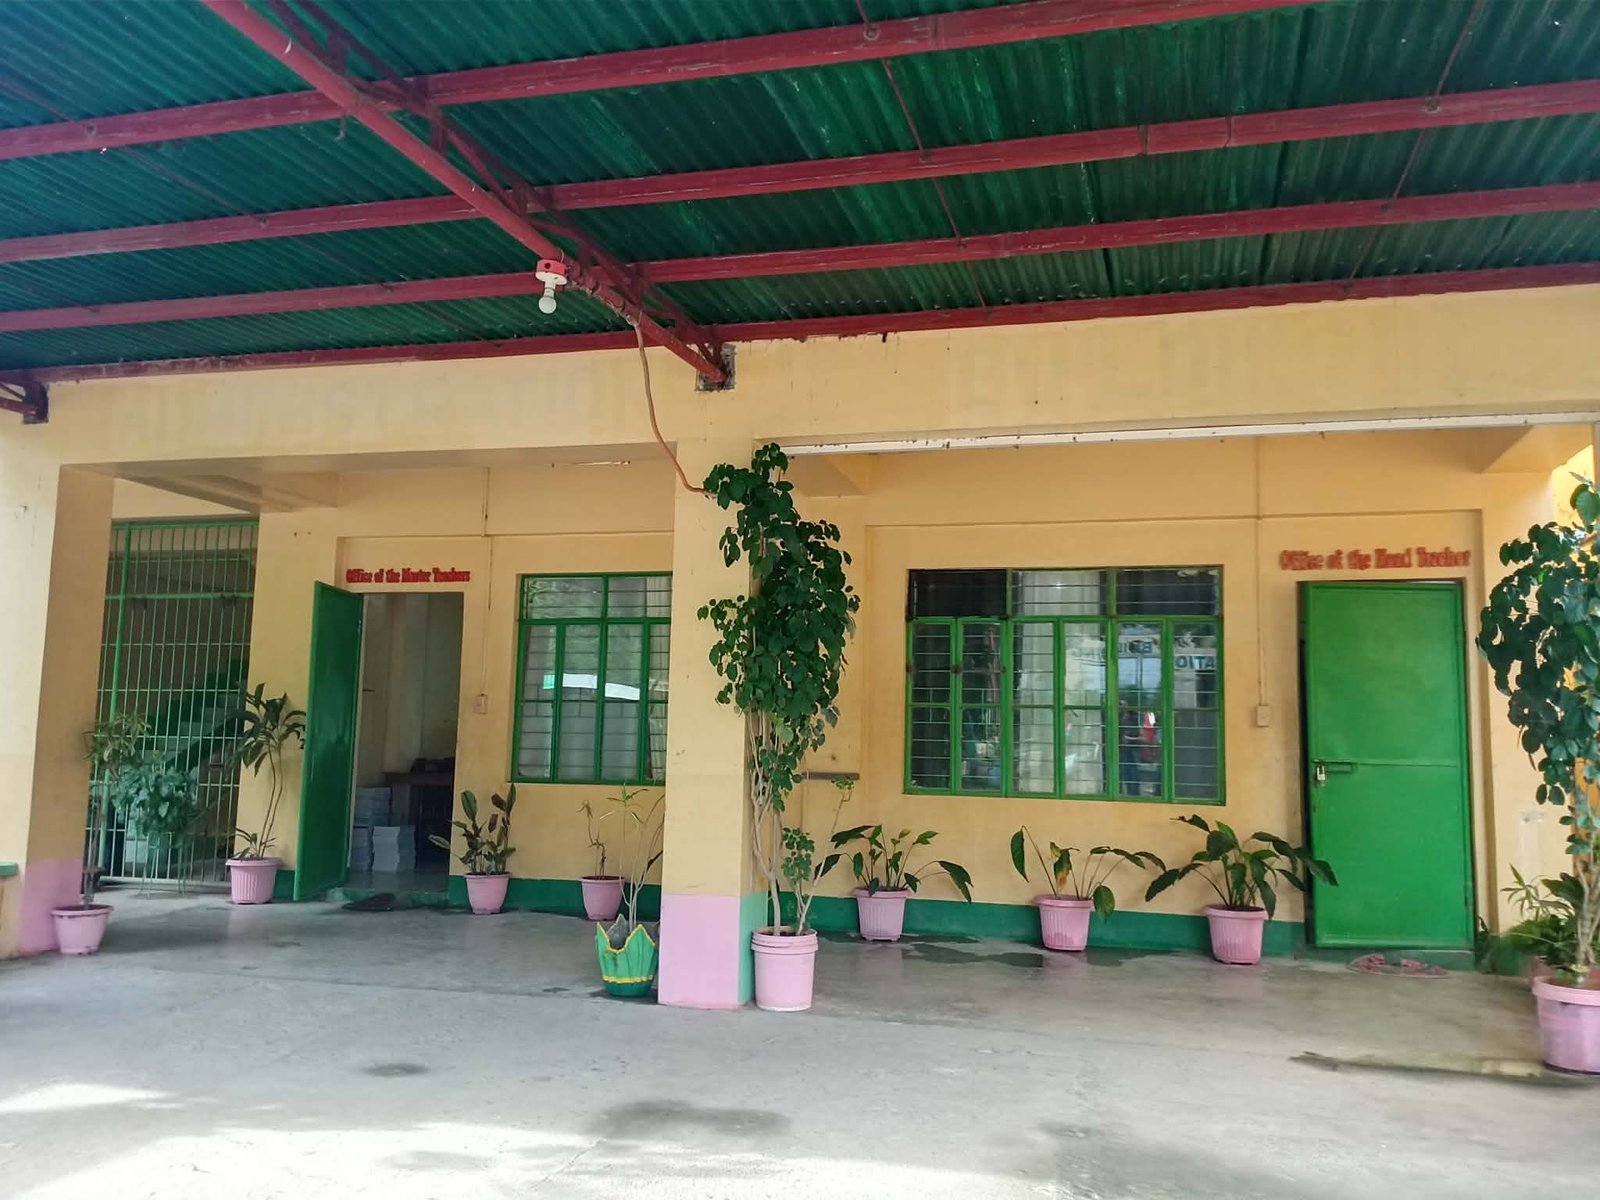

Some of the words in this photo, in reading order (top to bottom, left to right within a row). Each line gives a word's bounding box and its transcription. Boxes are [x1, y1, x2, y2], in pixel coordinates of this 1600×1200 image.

[1279, 550, 1324, 570] Office
[1326, 550, 1343, 569] of
[1347, 550, 1371, 570] the
[346, 568, 373, 583] Office
[374, 568, 384, 583] of
[386, 568, 400, 583] the
